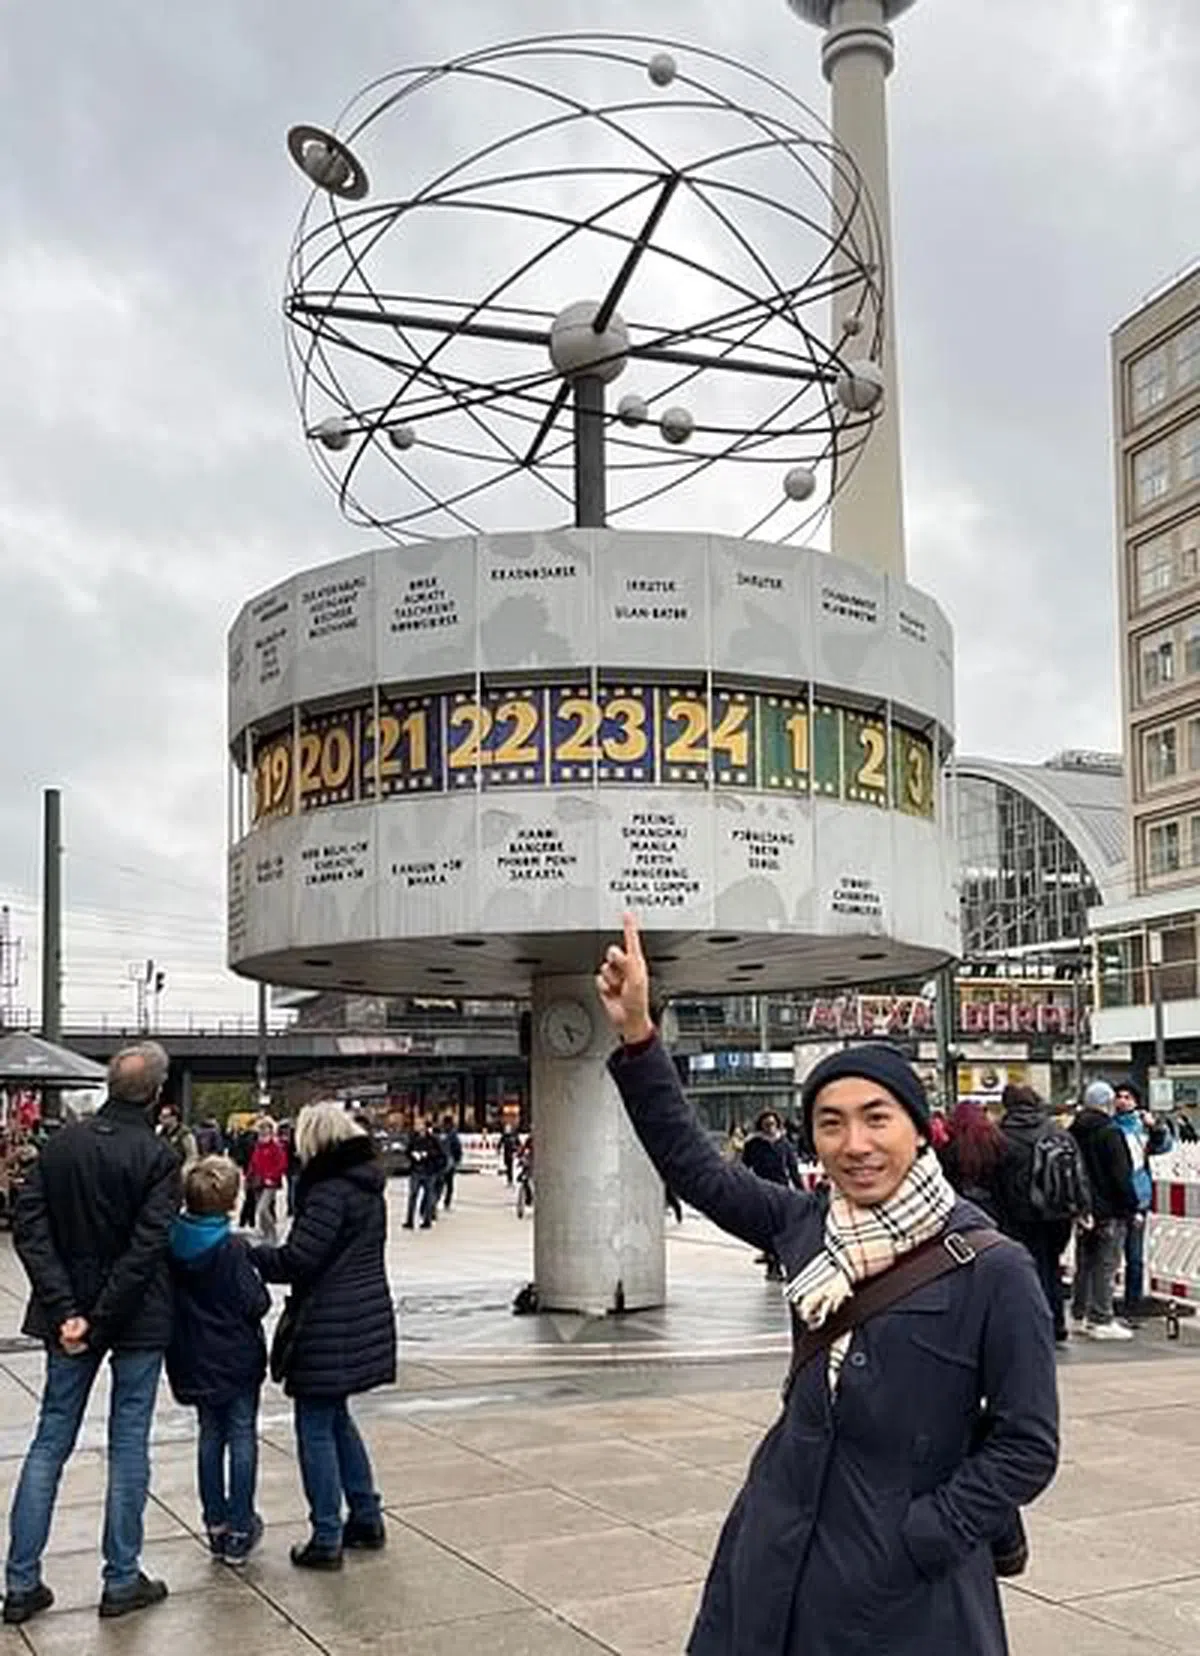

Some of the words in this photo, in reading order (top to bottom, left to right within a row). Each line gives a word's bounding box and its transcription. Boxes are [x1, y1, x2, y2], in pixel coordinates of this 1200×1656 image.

[300, 729, 351, 793] 20
[365, 712, 427, 778] 21
[449, 703, 538, 768] 22
[556, 699, 647, 762] 23
[664, 702, 748, 765] 24
[786, 714, 808, 772] 1
[858, 729, 885, 787] 2
[908, 747, 924, 804] 3
[633, 815, 675, 826] PEKING
[622, 828, 687, 839] SHANGHAI
[630, 841, 677, 852] MANILA
[636, 855, 673, 866] PERTH
